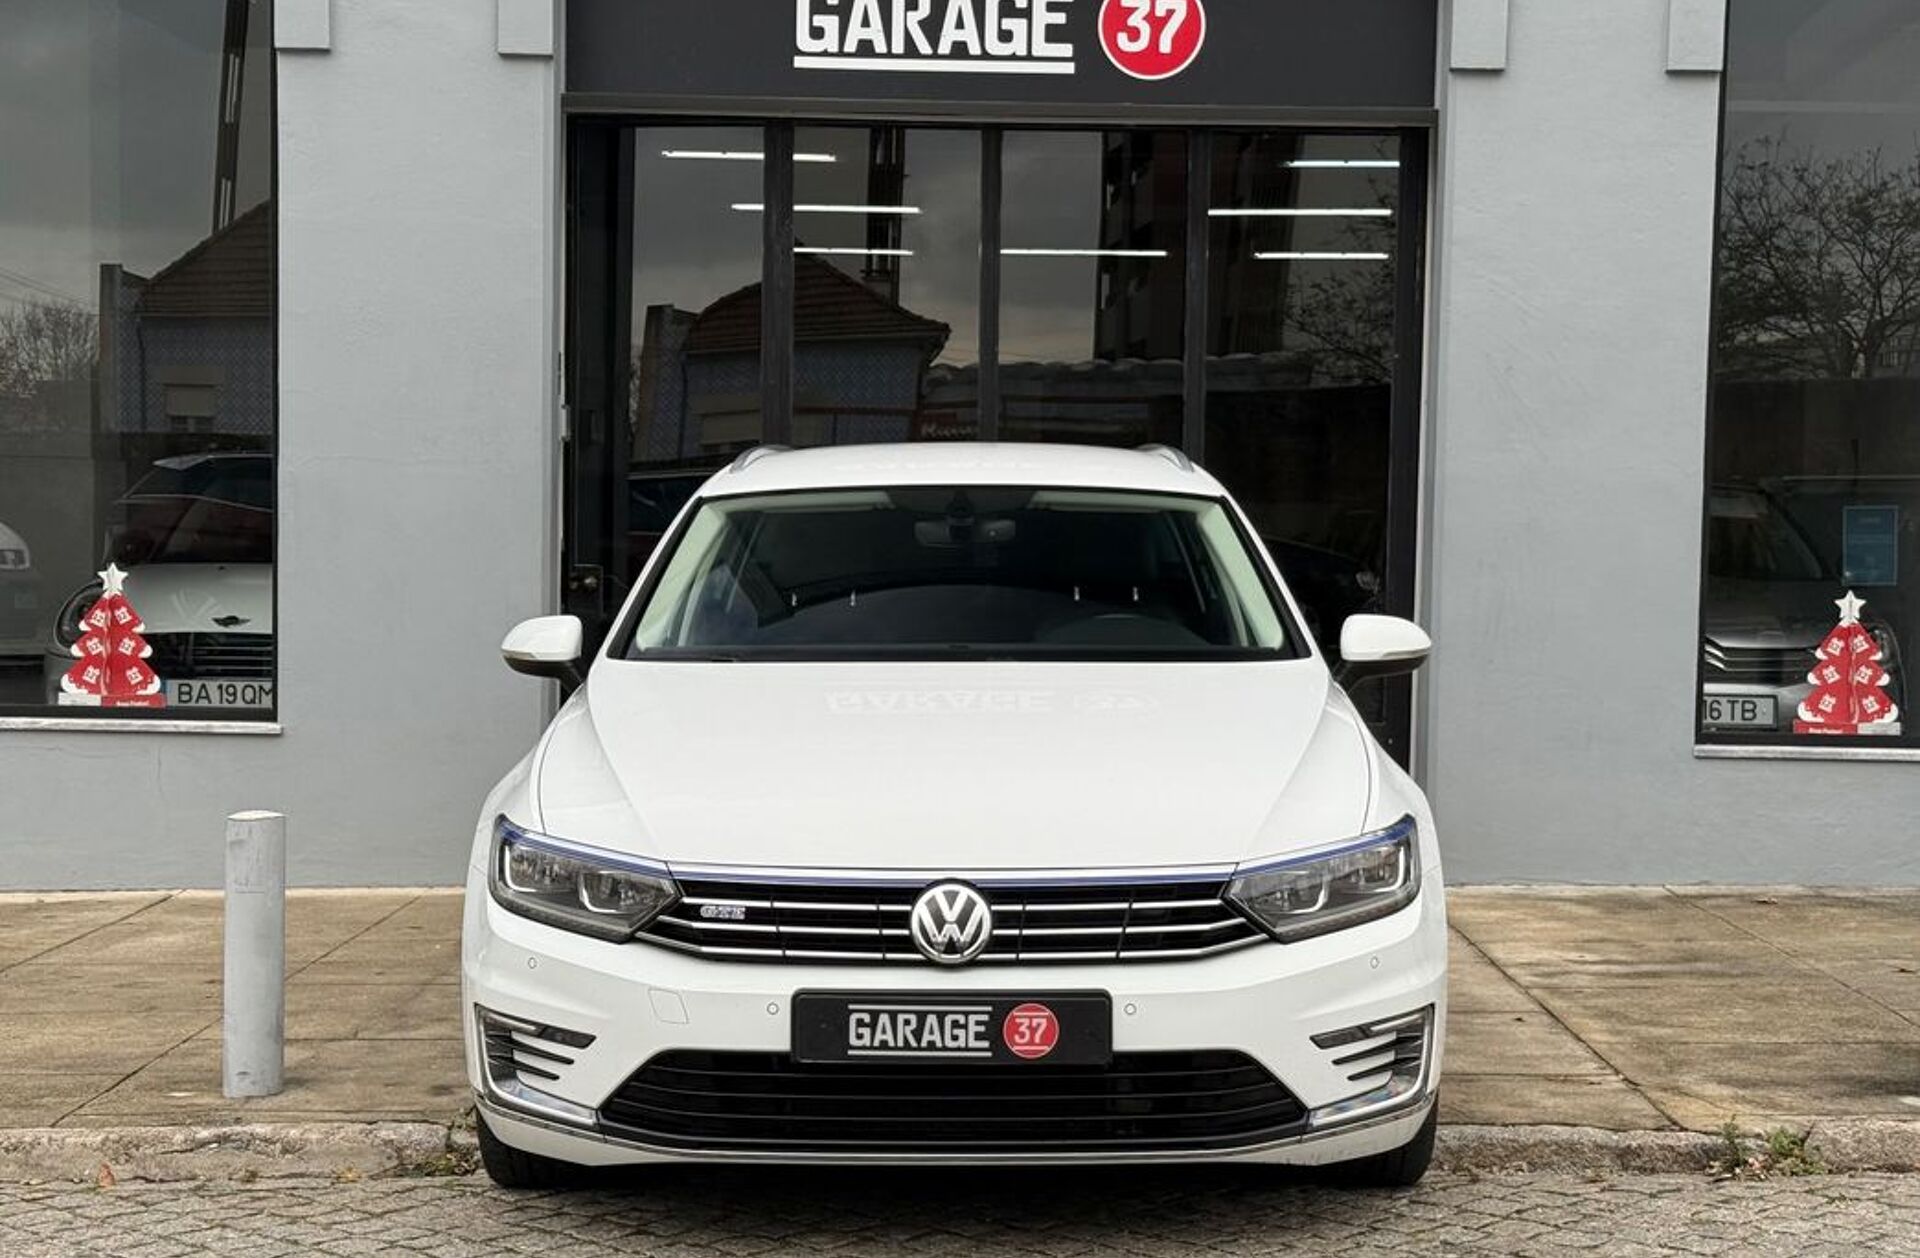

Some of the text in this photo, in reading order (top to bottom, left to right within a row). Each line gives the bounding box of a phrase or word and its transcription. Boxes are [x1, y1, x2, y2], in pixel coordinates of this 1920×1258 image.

[795, 0, 1187, 57] GARAGE 37
[177, 683, 212, 704] BA
[217, 683, 237, 704] 19
[1727, 700, 1757, 720] TB
[849, 1012, 1048, 1048] GARAGE 37
